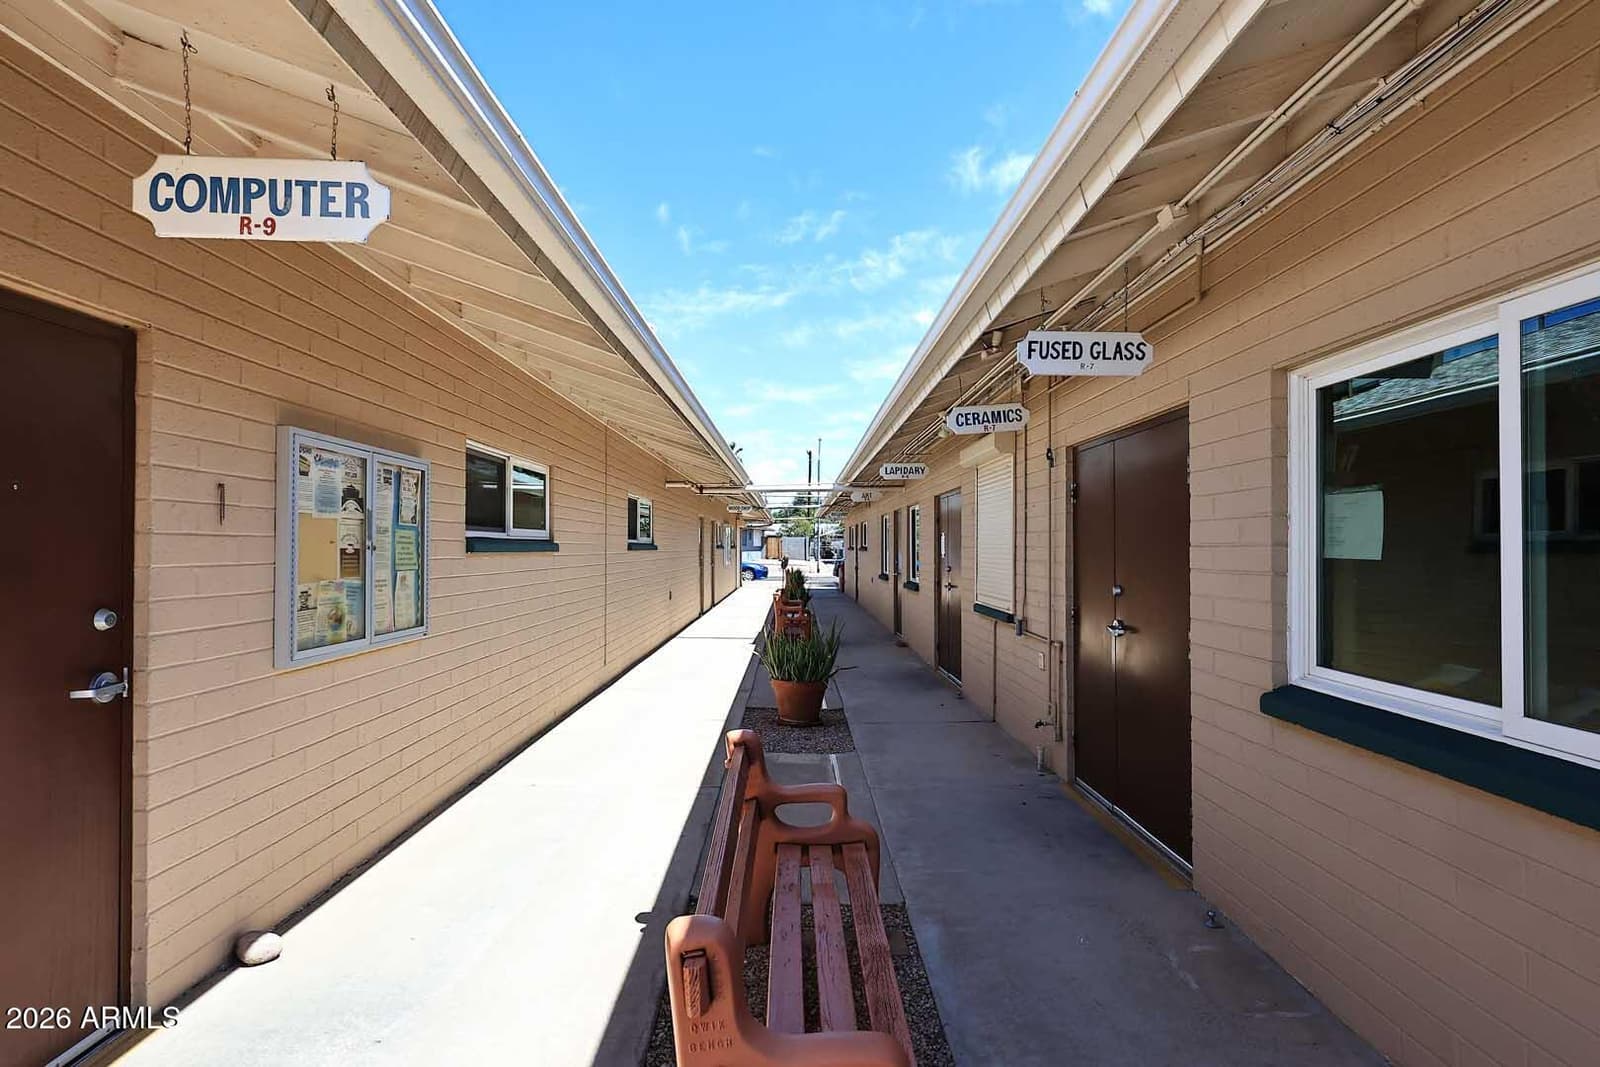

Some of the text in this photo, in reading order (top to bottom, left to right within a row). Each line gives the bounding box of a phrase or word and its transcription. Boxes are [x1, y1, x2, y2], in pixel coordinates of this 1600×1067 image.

[149, 172, 370, 219] COMPUTER
[239, 216, 277, 236] R-9
[1027, 340, 1147, 361] FUSED GLASS
[955, 409, 1023, 427] CERAMICS
[884, 466, 926, 475] LAPIDARY
